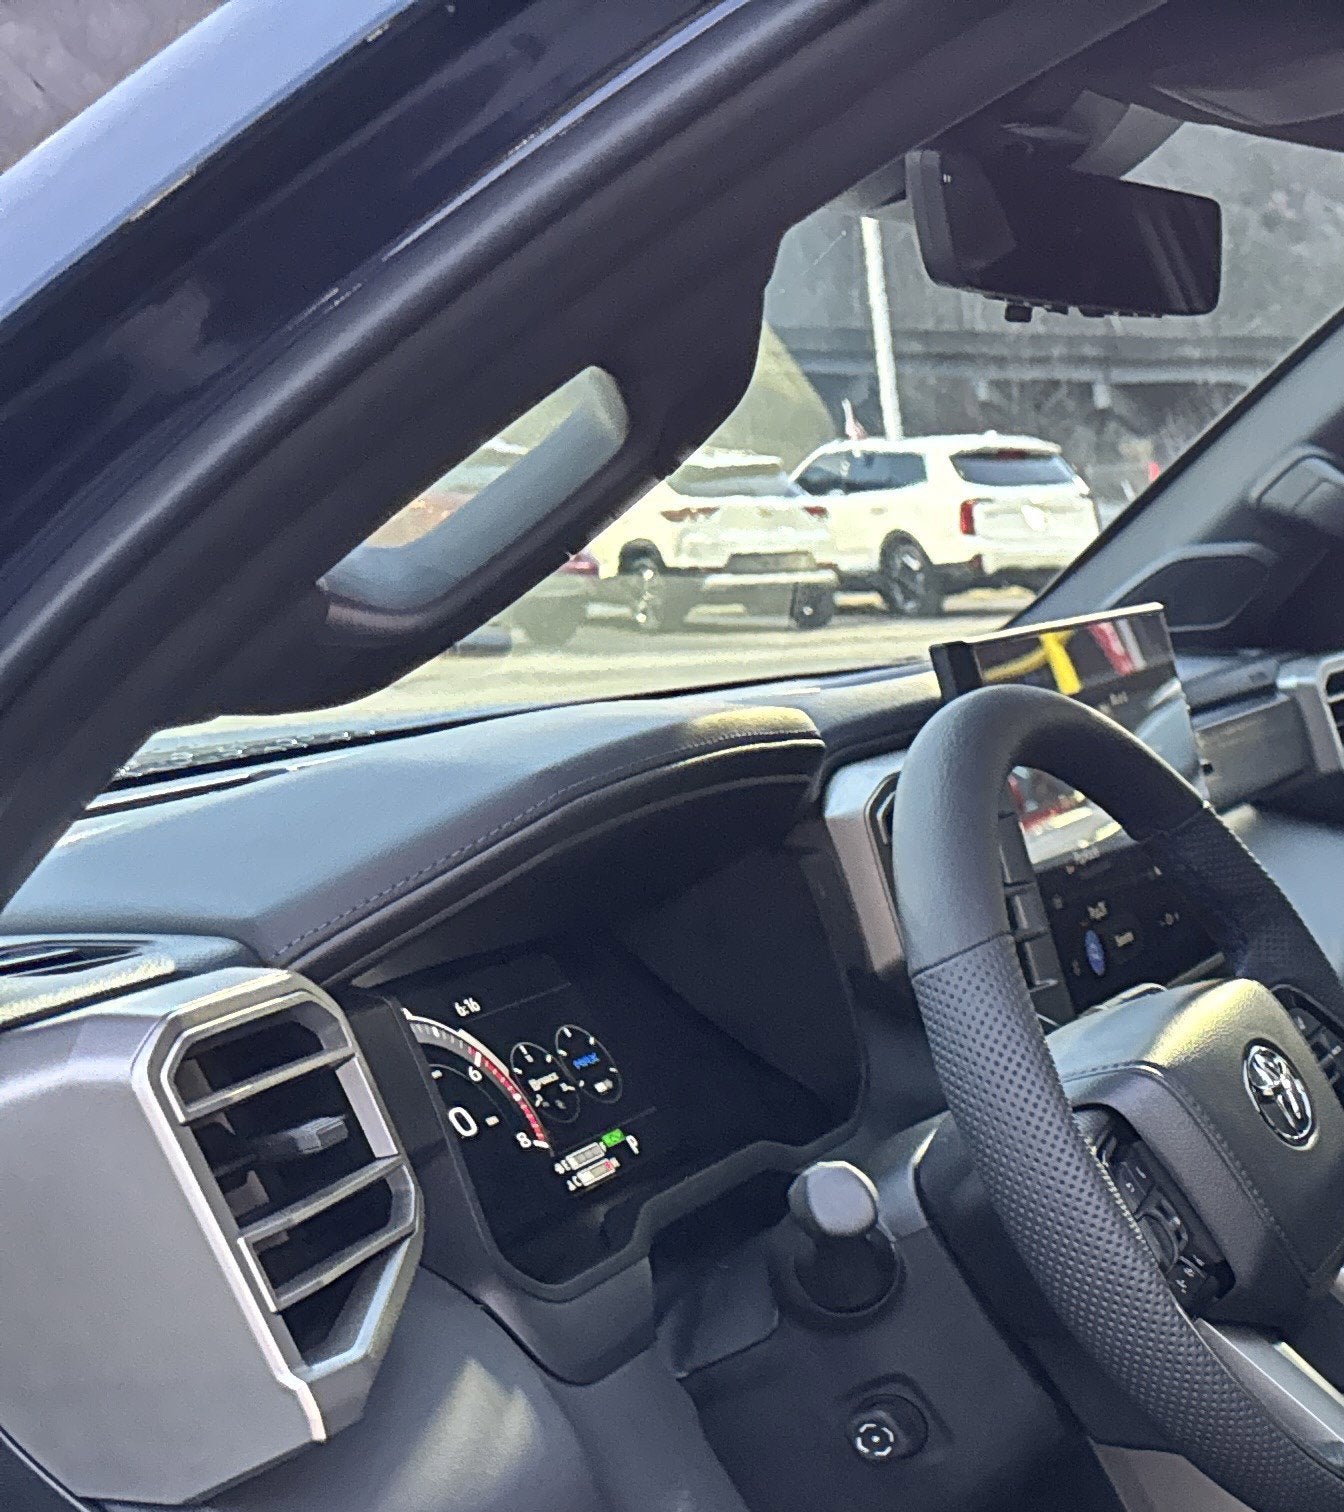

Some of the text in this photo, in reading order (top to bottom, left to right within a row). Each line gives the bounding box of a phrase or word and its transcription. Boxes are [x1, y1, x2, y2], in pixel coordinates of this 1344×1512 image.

[468, 1065, 483, 1082] 6
[448, 1106, 478, 1137] 0
[516, 1131, 532, 1149] 8
[626, 1135, 640, 1155] P
